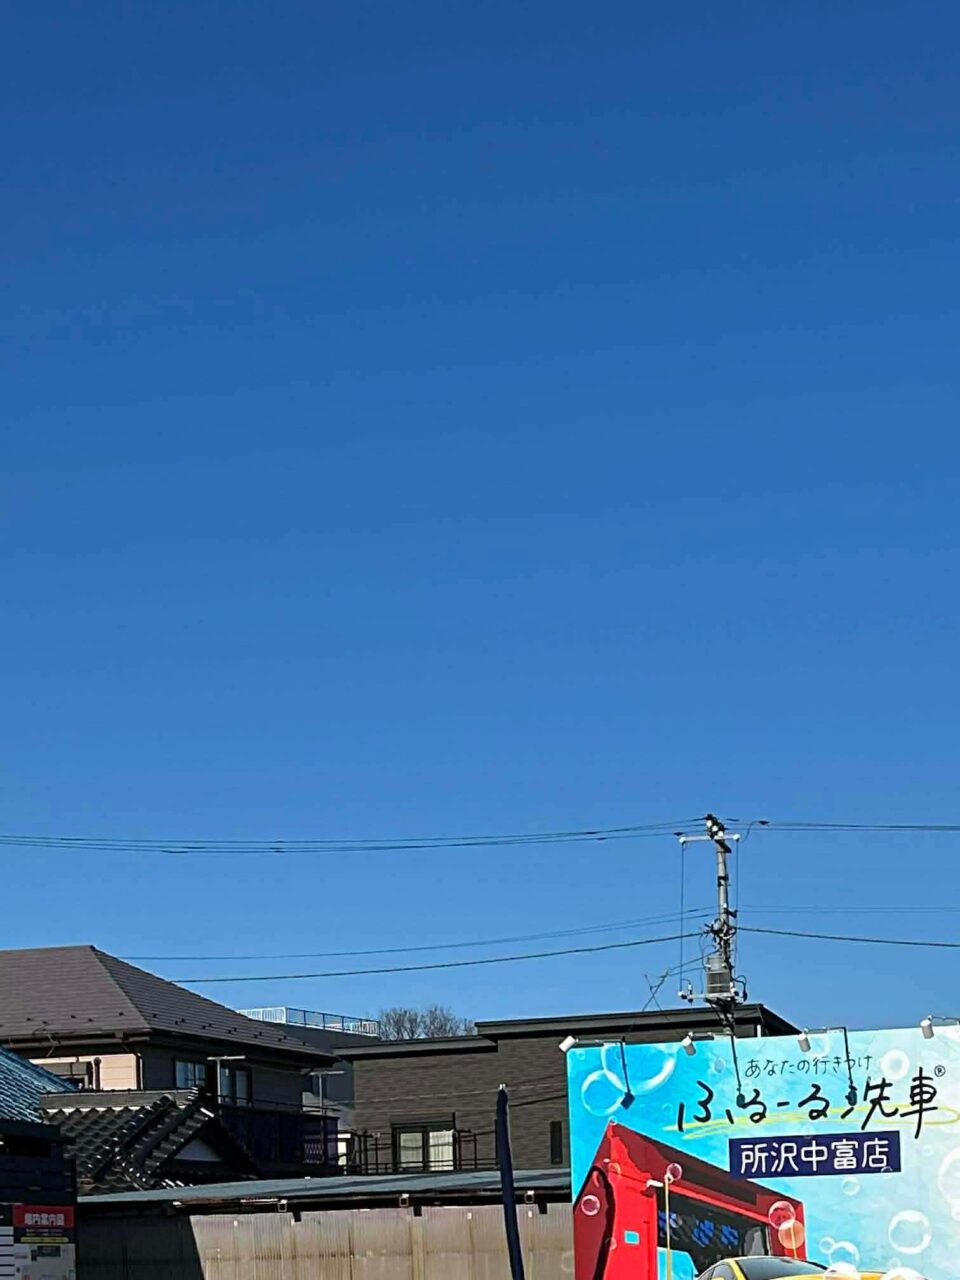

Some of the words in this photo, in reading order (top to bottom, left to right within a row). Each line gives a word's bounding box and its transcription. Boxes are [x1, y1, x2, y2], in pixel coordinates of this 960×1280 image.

[744, 1055, 873, 1078] あなたの行きつけ
[740, 1138, 889, 1174] 所沢中富店
